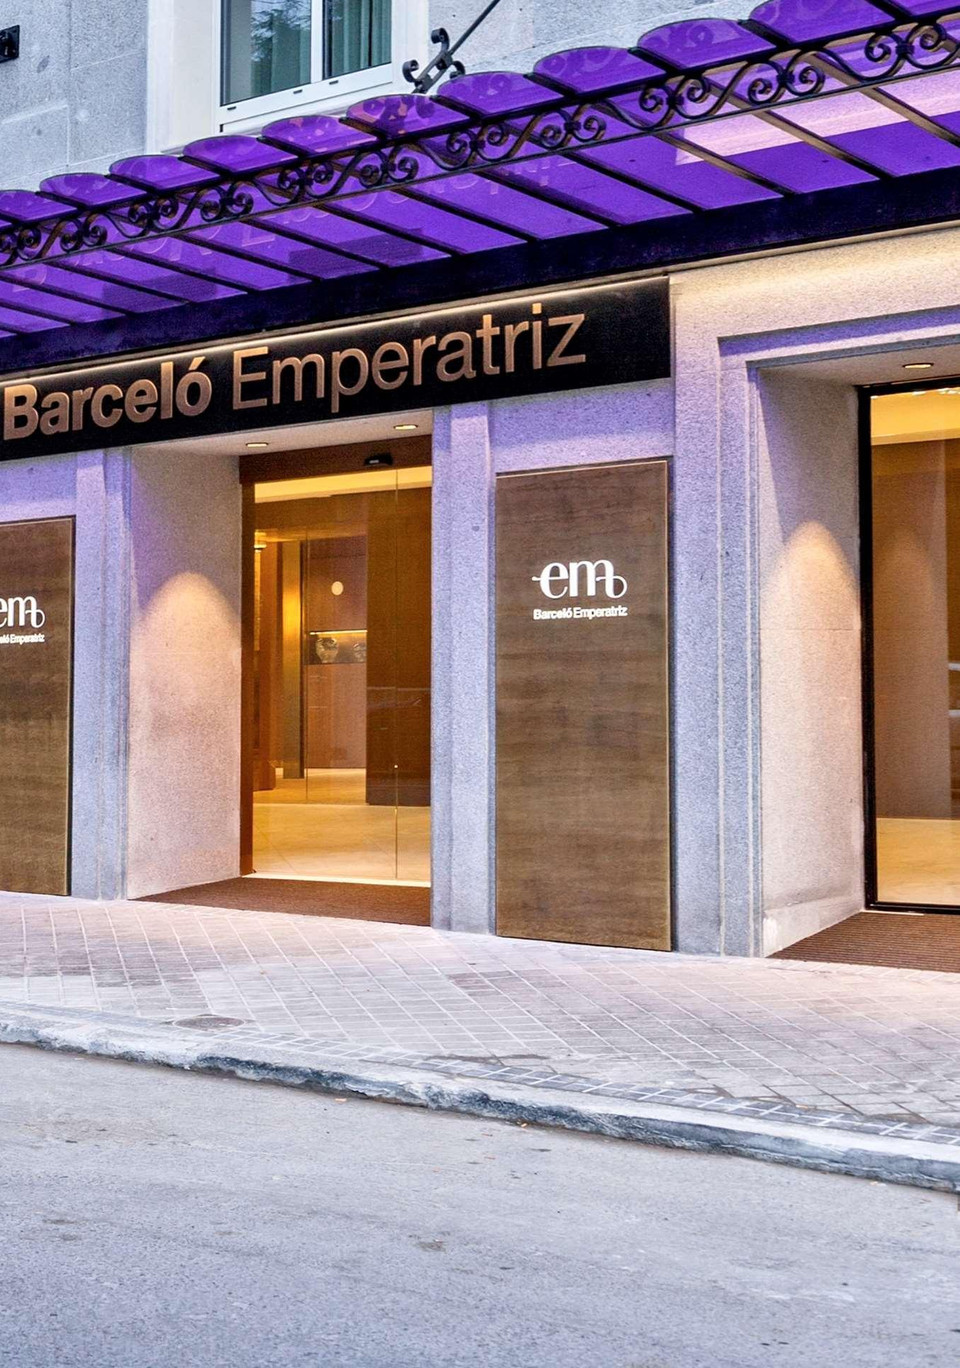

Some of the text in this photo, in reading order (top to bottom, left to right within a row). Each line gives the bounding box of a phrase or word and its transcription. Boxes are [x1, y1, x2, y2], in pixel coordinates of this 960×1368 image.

[3, 303, 588, 441] Barceló Emperatriz
[531, 559, 628, 599] em
[533, 605, 628, 620] Barceló Emperatriz
